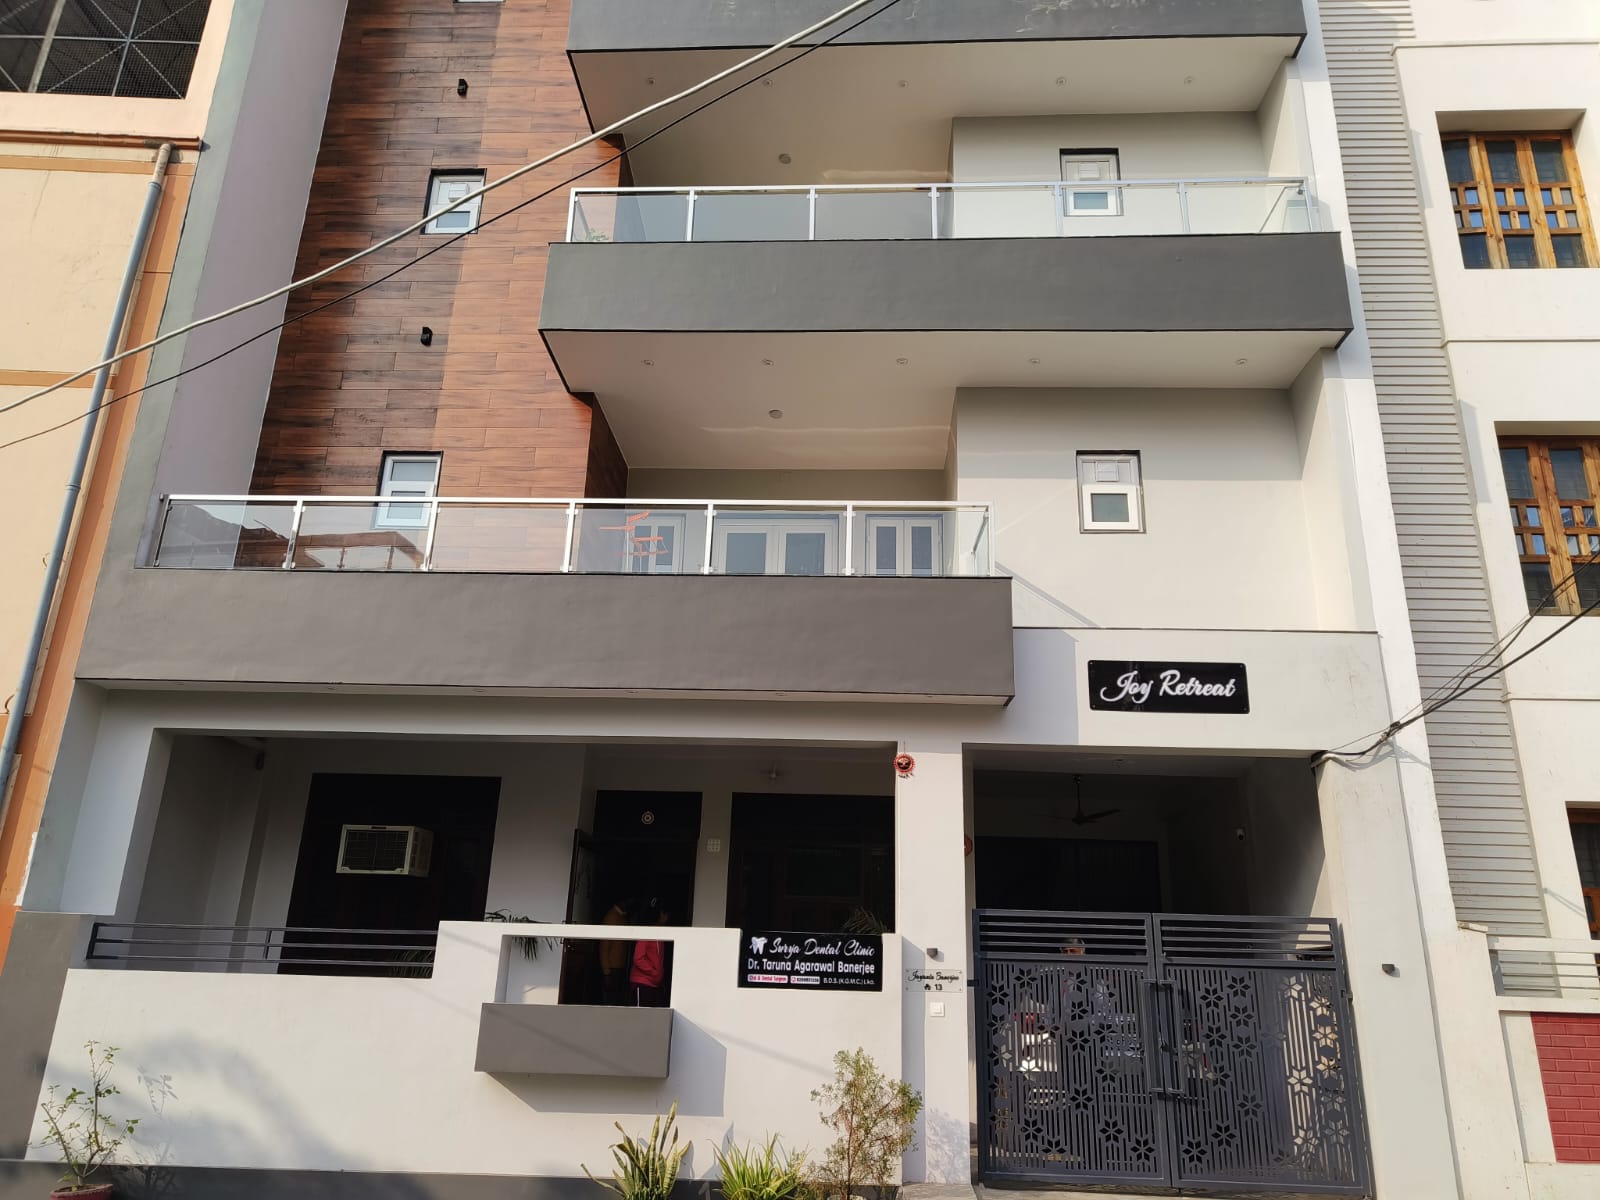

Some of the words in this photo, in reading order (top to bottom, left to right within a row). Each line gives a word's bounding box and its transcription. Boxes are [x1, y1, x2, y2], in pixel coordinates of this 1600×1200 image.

[1099, 670, 1154, 704] Joy
[1159, 669, 1236, 697] Retreat
[769, 937, 800, 958] Surya
[804, 938, 840, 957] Dental
[843, 939, 875, 957] Clinic
[747, 958, 760, 970] Dr.
[762, 958, 792, 971] Taruna
[794, 960, 835, 974] Agarawal
[838, 961, 875, 975] Banerjee
[934, 983, 943, 991] 13
